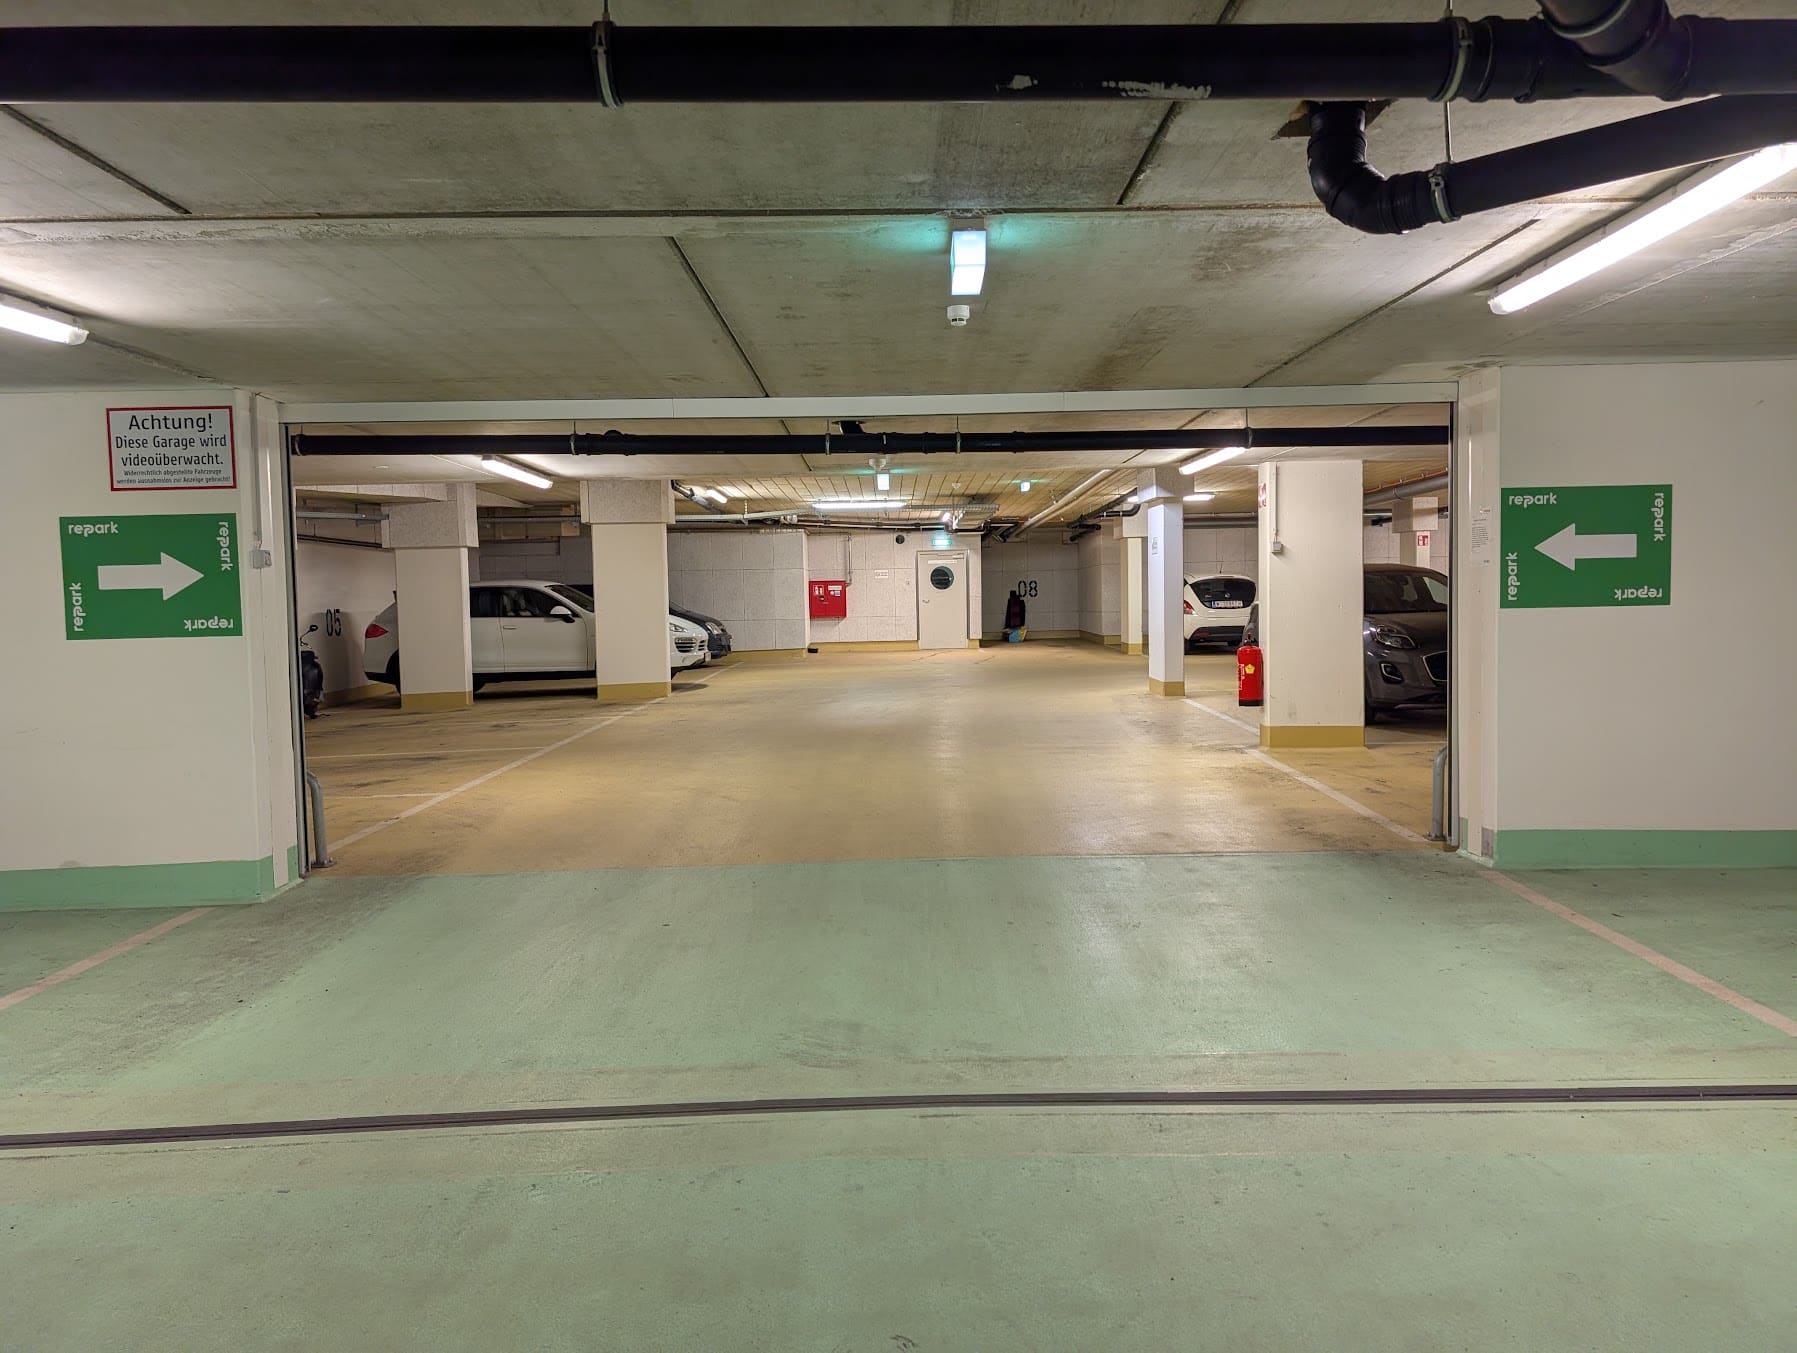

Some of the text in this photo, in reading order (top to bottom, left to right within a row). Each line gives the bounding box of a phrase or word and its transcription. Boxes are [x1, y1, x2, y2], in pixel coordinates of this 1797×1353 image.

[128, 413, 213, 432] Achtung!
[115, 433, 227, 450] Diese Garage wird
[121, 452, 224, 467] videoüberwacht.
[123, 469, 162, 477] Widerrechtlich
[194, 468, 222, 476] Fahrzeuge
[1508, 492, 1558, 508] repark
[1651, 492, 1666, 542] repark
[68, 521, 119, 537] repark
[216, 521, 233, 571] repark
[1506, 552, 1520, 601] repark
[1018, 580, 1038, 598] 08
[1614, 585, 1663, 601] repark
[69, 582, 86, 632] repark
[184, 616, 234, 632] repark
[326, 608, 342, 637] 05
